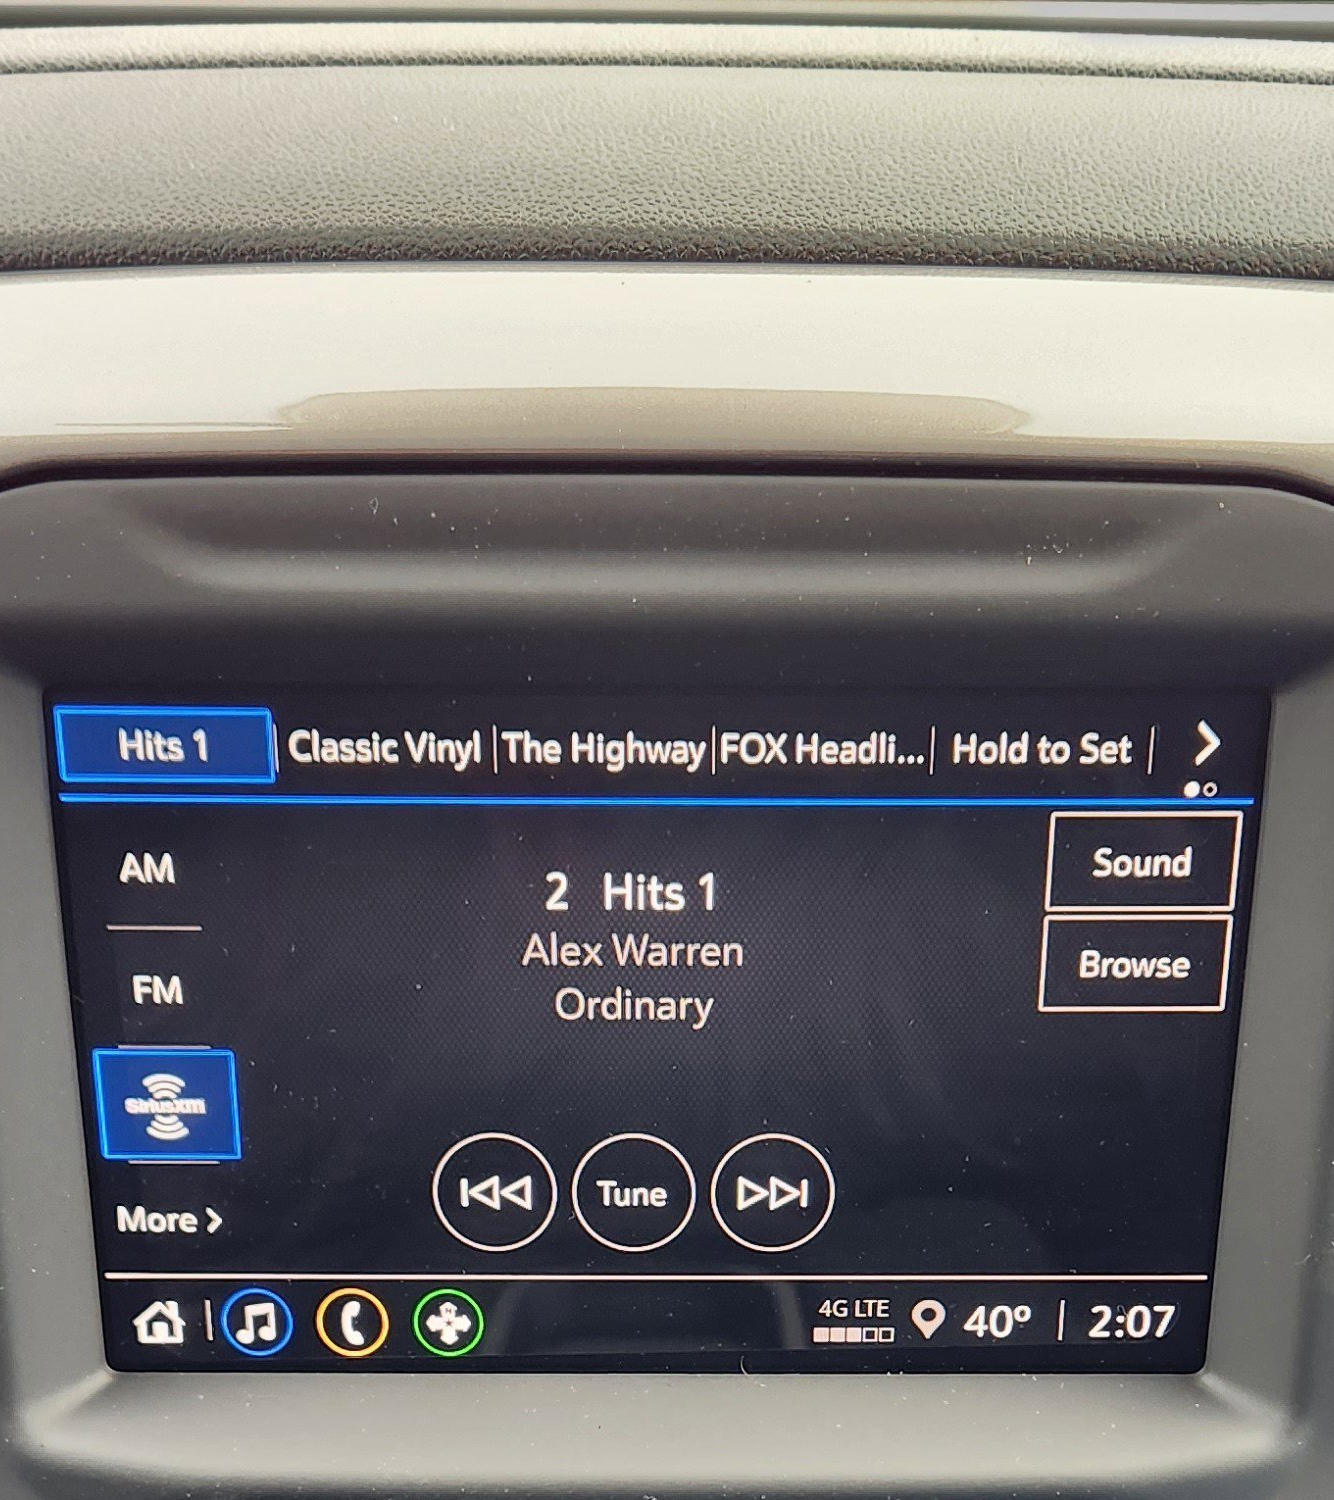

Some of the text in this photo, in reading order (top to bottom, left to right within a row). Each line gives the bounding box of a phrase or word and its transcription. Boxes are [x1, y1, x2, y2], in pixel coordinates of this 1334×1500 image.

[118, 728, 208, 762] Hits 1
[288, 728, 481, 772] Classic Vinyl
[501, 730, 707, 773] The Highway
[720, 730, 925, 765] FOX Headli...
[952, 731, 1133, 765] Hold to Set
[119, 852, 176, 884] AM
[1092, 846, 1193, 878] Sound
[544, 871, 715, 911] 2 Hits 1
[521, 931, 744, 967] Alex Warren
[1079, 950, 1191, 979] Browse
[132, 975, 184, 1005] FM
[555, 986, 715, 1030] Ordinary
[596, 1179, 667, 1207] Tune
[116, 1205, 198, 1233] More
[818, 1299, 890, 1318] 4G LTE
[1088, 1304, 1176, 1339] 2:07
